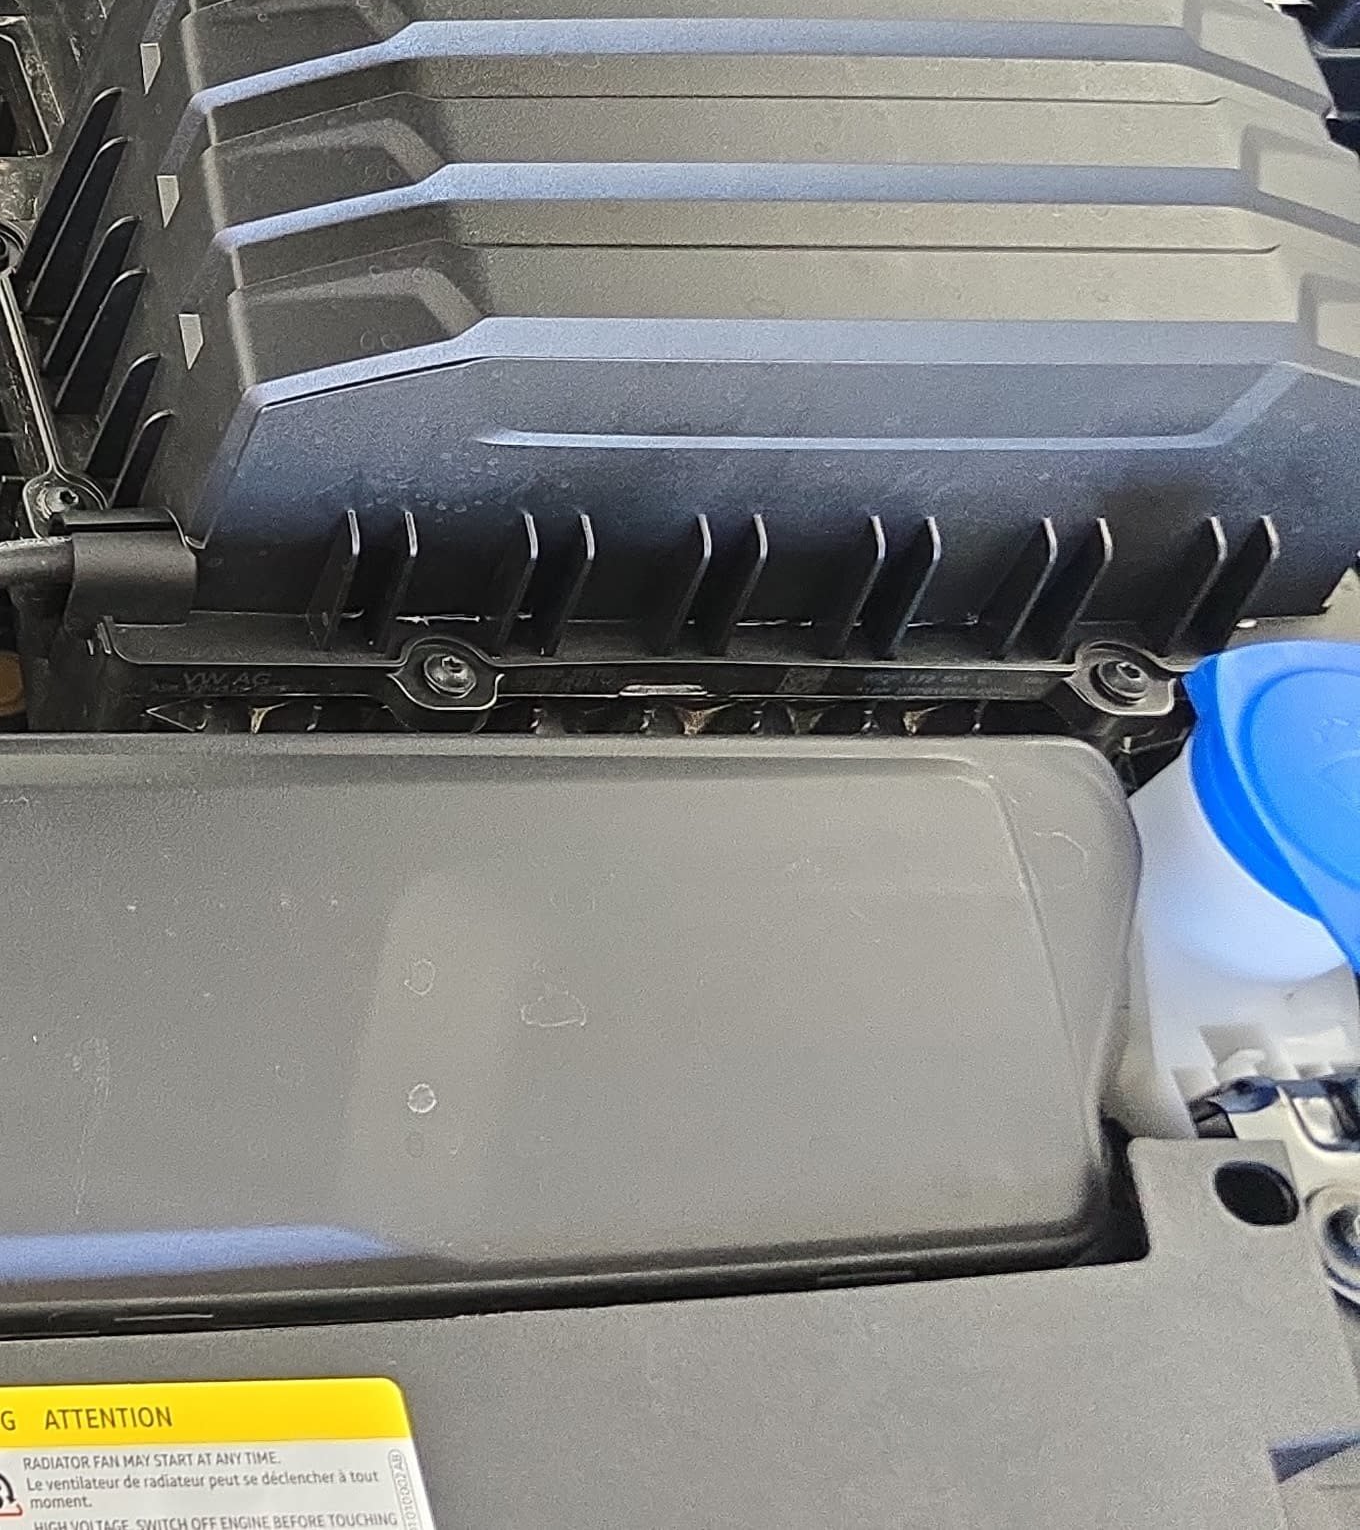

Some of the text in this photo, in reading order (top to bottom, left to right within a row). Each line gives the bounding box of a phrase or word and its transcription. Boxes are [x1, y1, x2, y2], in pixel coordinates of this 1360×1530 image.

[44, 1405, 173, 1431] ATTENTION
[23, 1452, 281, 1470] RADIATOR FAN MAY START AT ANY TIME.
[27, 1469, 379, 1491] Le ventilateur de radiateur peut se déclencher à tout
[30, 1494, 92, 1510] moment.
[135, 1517, 188, 1530] SWITCH
[191, 1516, 218, 1529] OFF
[221, 1515, 270, 1528] ENGINE
[273, 1513, 325, 1527] BEFORE
[328, 1511, 398, 1526] TOUCHING
